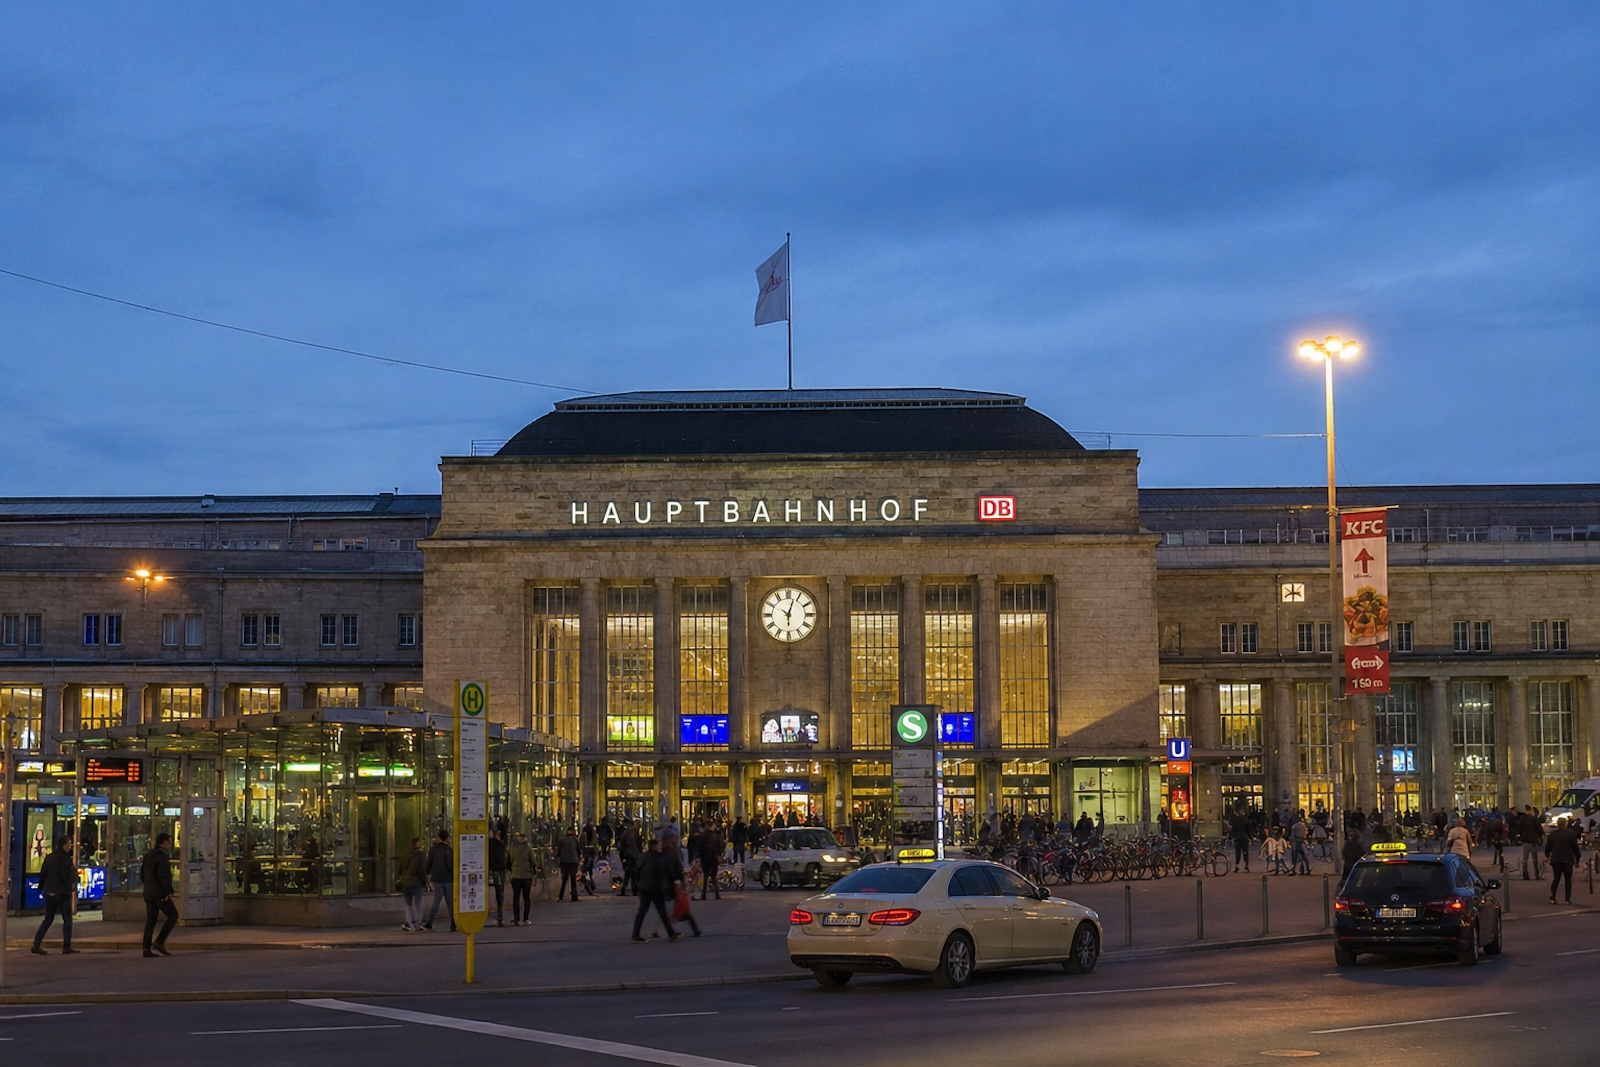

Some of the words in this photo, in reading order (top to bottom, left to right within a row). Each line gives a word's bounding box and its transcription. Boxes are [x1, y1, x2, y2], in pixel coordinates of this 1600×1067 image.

[571, 498, 928, 524] HAUPTBAHNHOF
[983, 500, 1011, 517] DB
[1345, 519, 1383, 536] KFC
[467, 690, 478, 709] H
[902, 713, 923, 739] S
[1171, 741, 1185, 758] U
